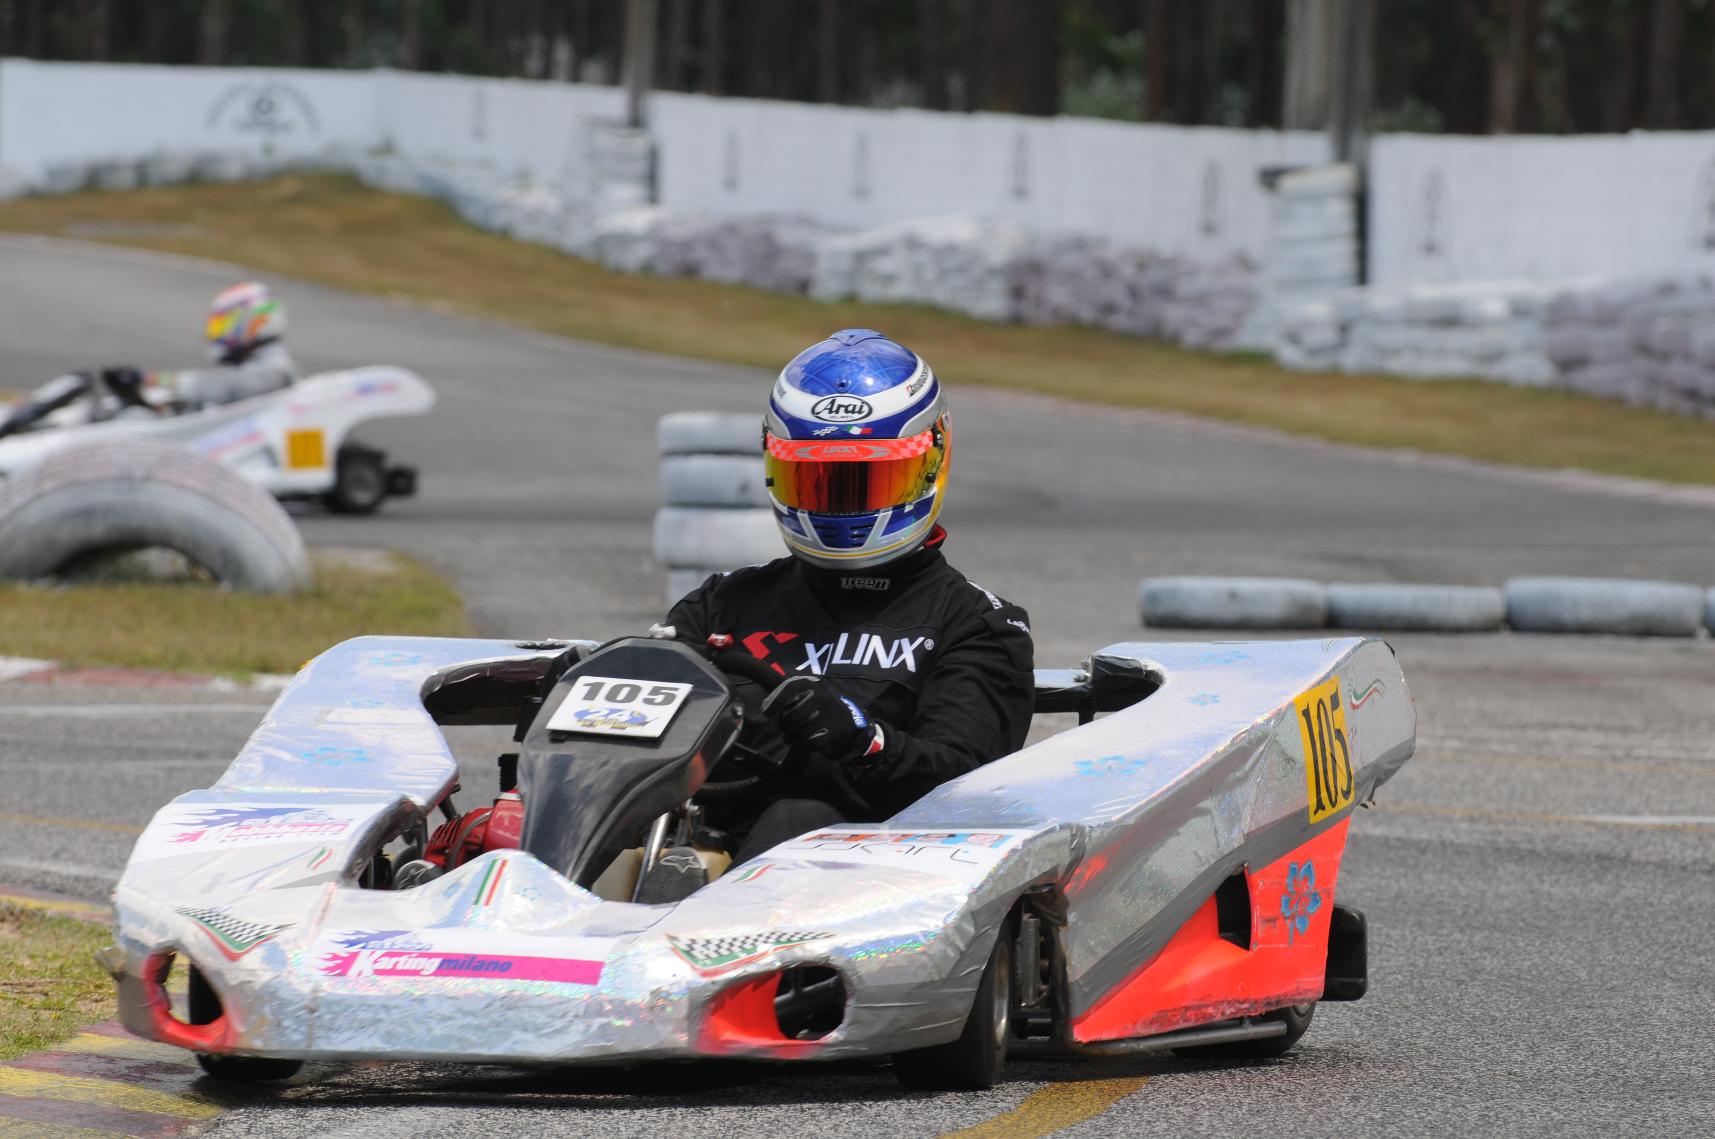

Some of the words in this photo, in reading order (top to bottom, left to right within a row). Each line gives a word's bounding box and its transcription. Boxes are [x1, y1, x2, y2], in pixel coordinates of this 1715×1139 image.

[815, 398, 866, 415] Arai
[582, 681, 680, 707] 105
[1302, 690, 1353, 816] 105
